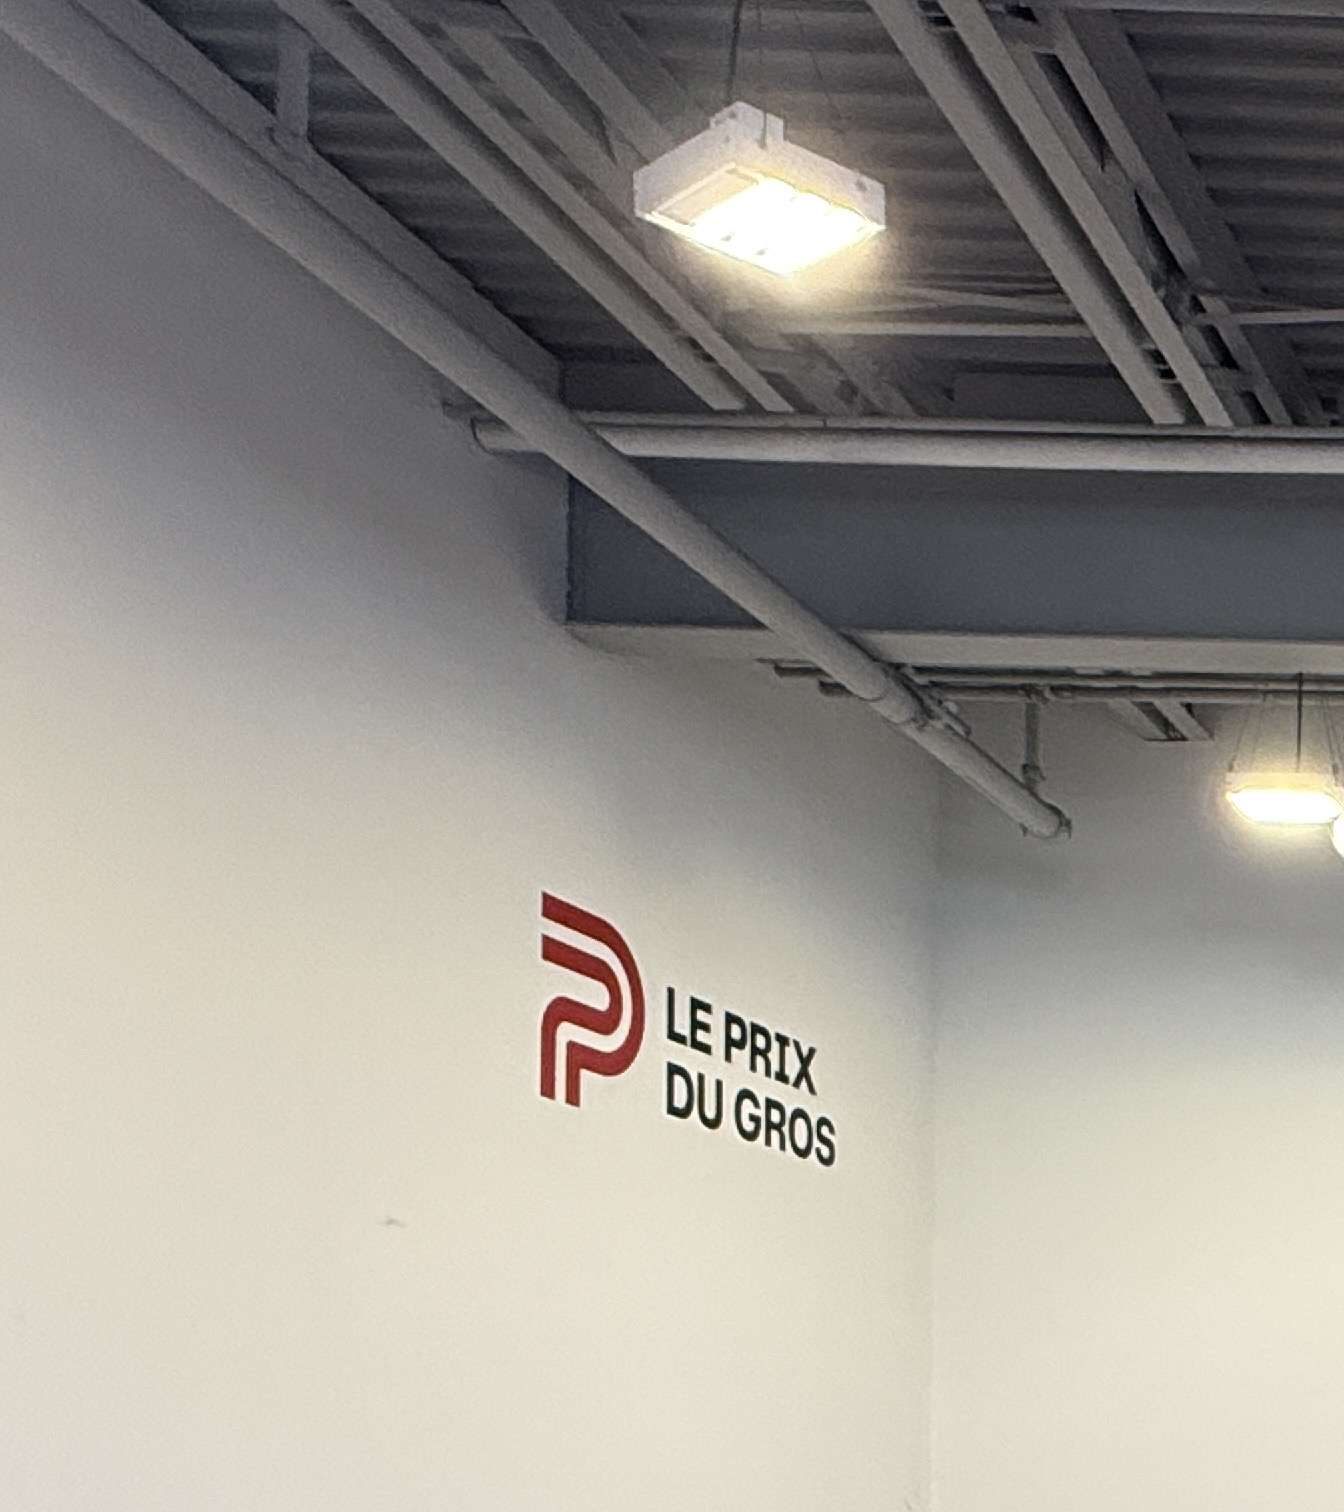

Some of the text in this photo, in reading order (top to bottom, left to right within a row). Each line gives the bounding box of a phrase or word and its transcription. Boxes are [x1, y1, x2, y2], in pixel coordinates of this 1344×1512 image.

[666, 986, 817, 1096] LE PRIX
[666, 1061, 836, 1167] DU GROS
